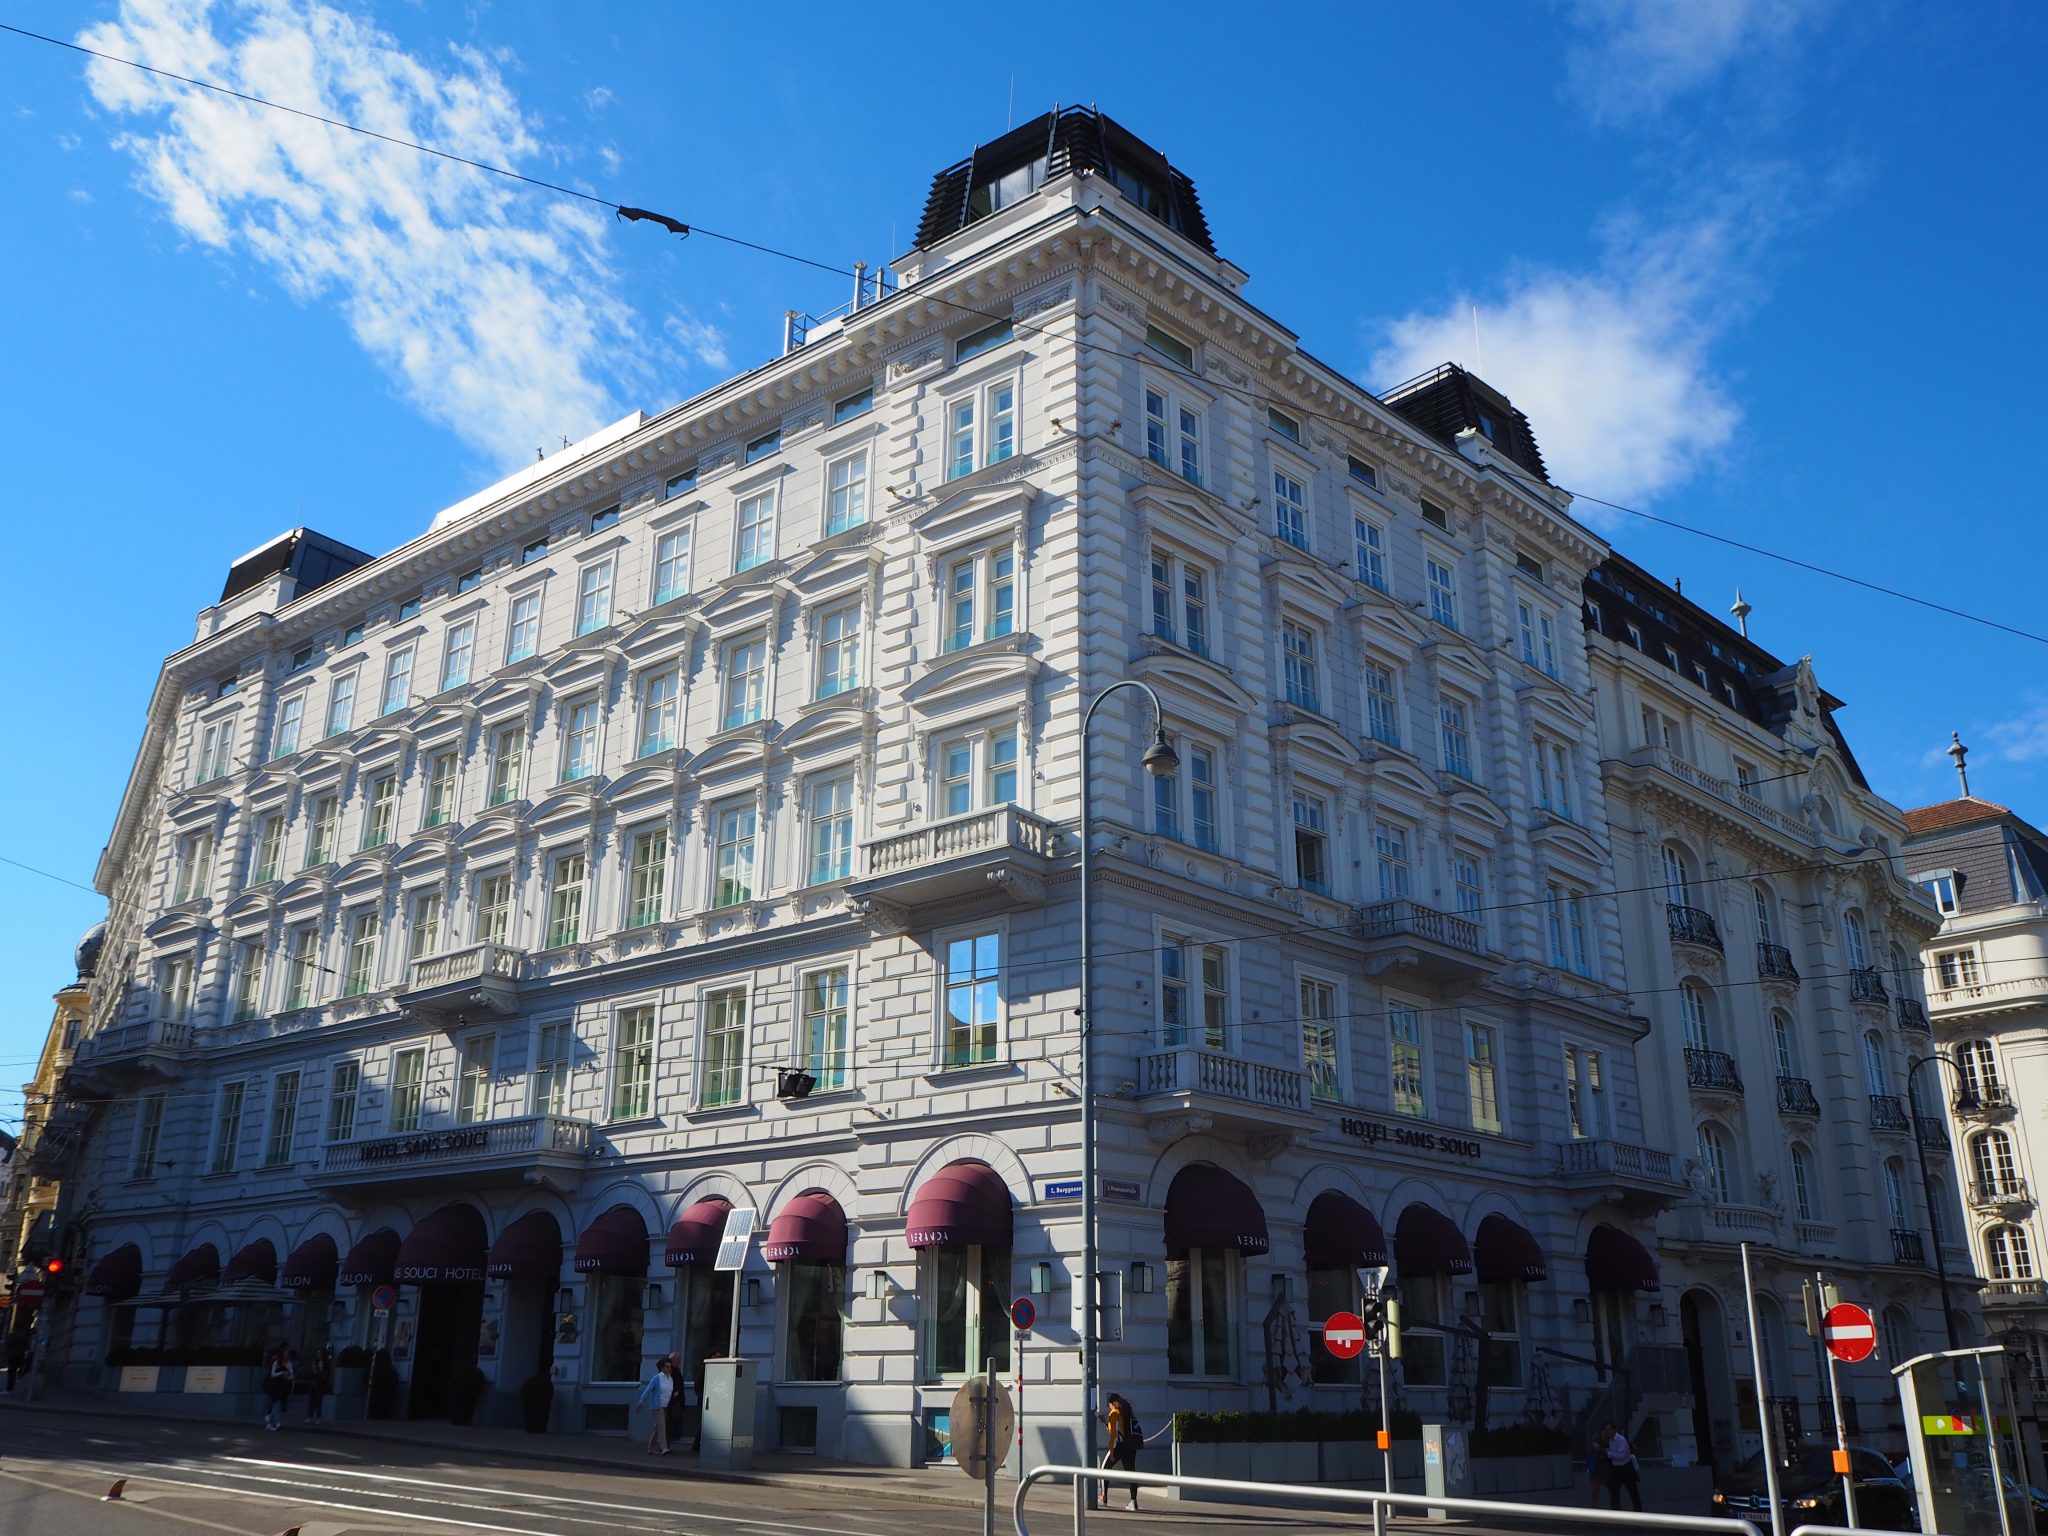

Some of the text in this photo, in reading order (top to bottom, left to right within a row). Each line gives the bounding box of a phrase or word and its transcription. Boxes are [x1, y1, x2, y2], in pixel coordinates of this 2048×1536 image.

[1341, 1117, 1481, 1158] HOTEL SANS SOUCI
[360, 1131, 489, 1161] HOTEL SANS SOUCI
[911, 1231, 949, 1243] VERANDA
[1237, 1235, 1268, 1247] VERAND
[404, 1267, 438, 1279] SOUCI
[445, 1267, 484, 1280] HOTEL
